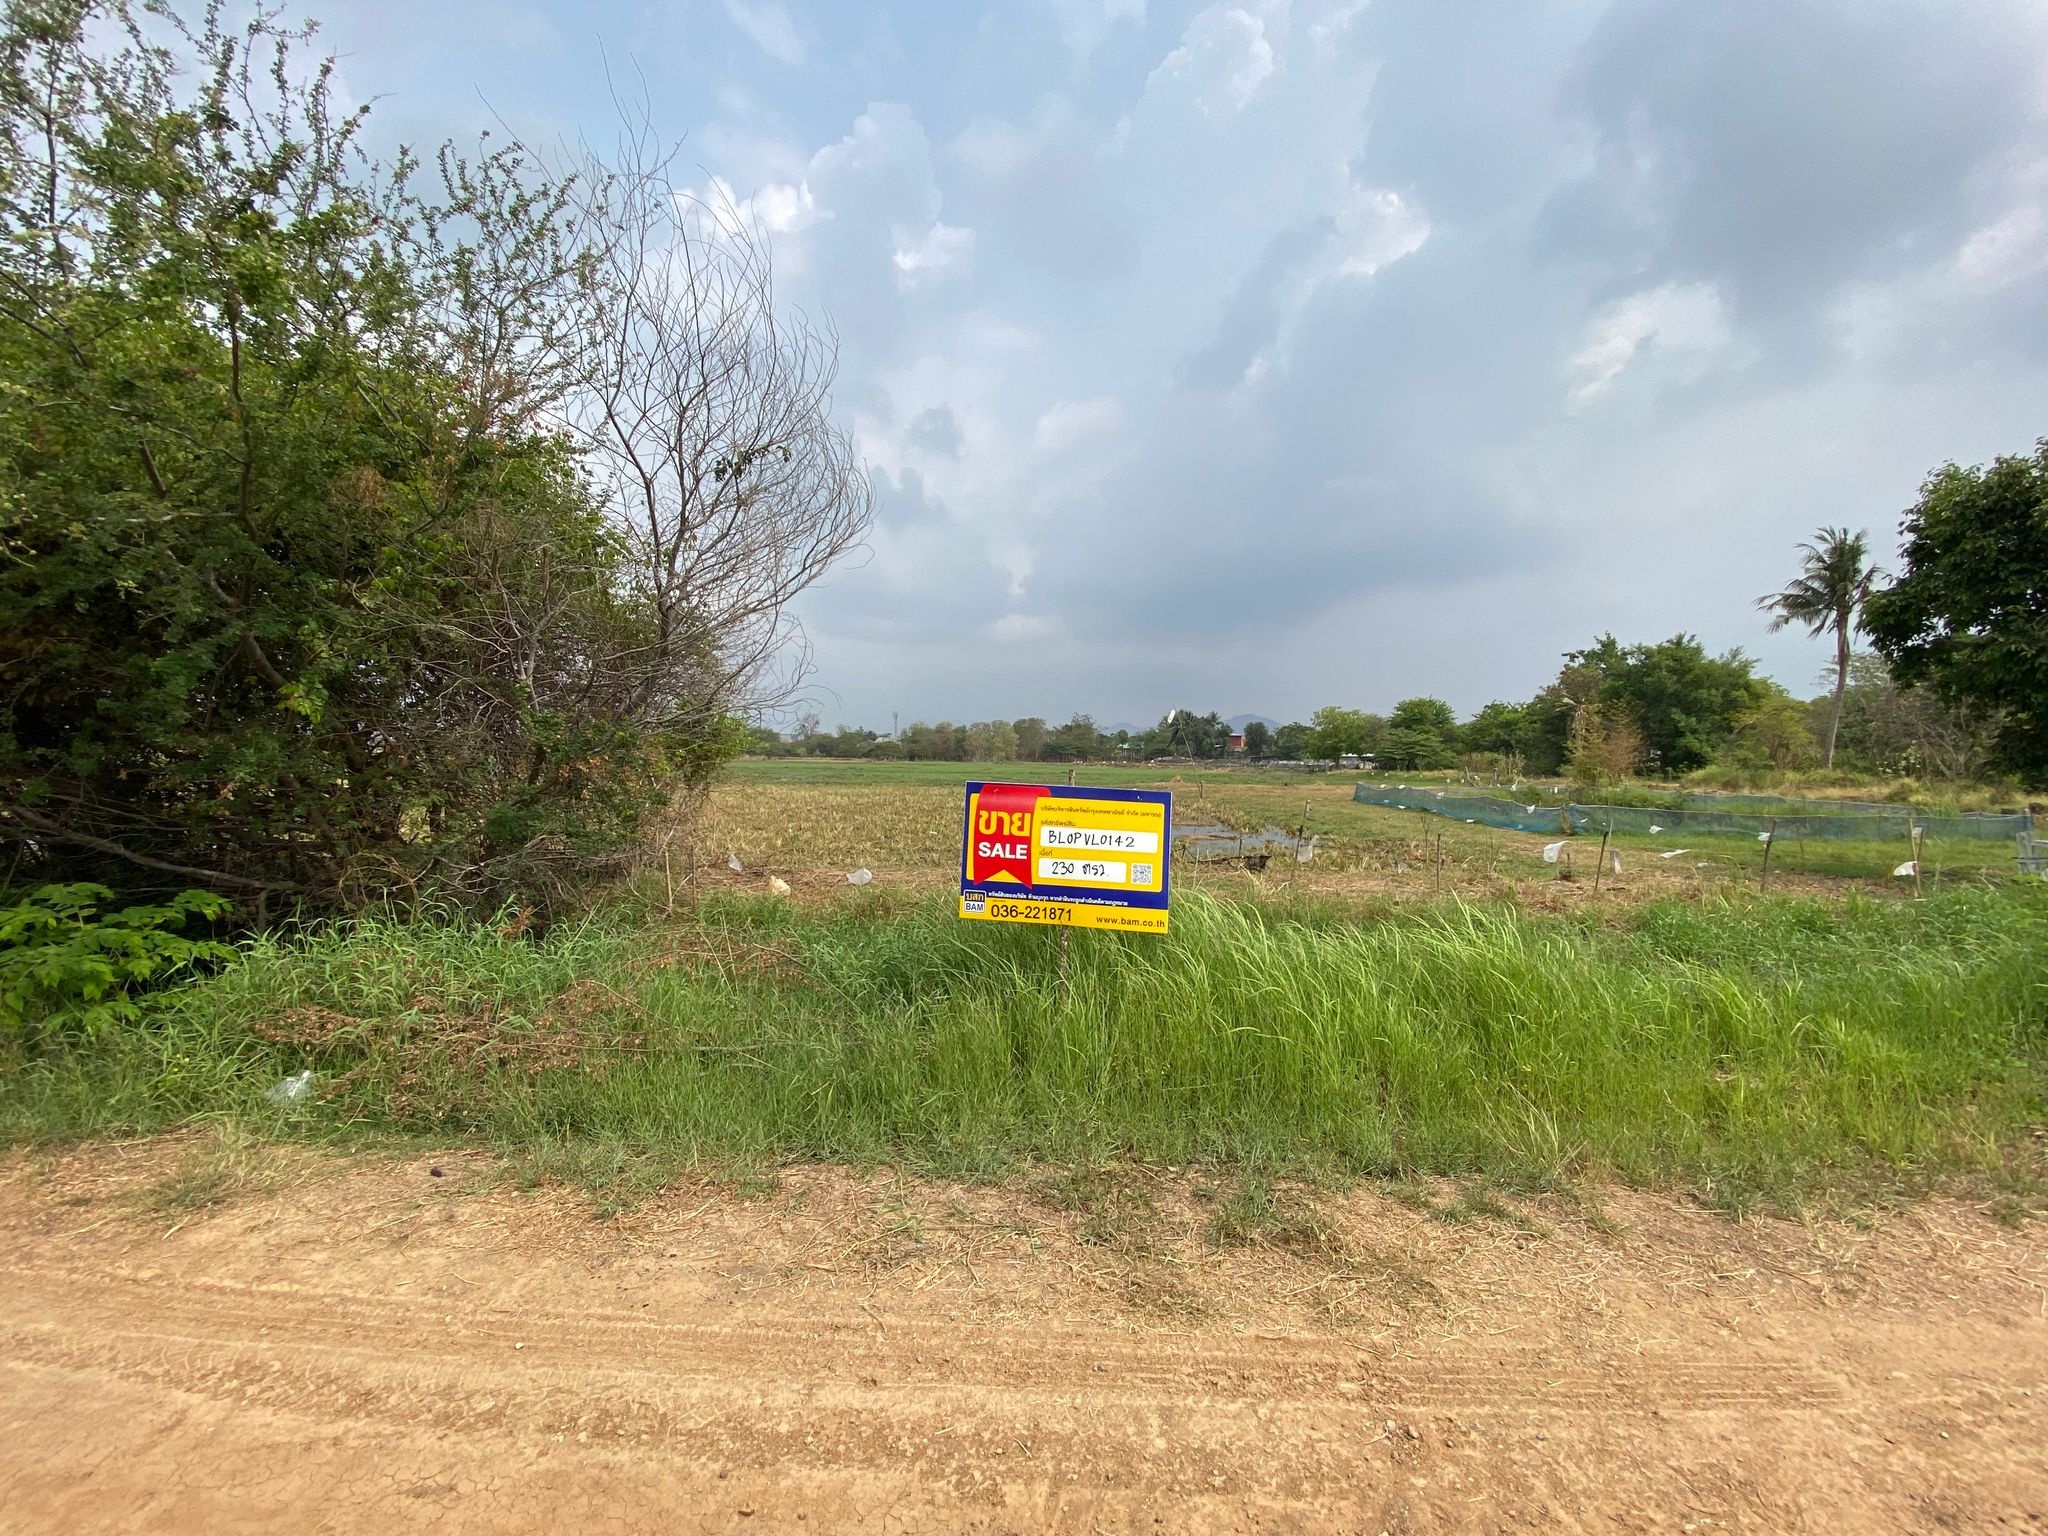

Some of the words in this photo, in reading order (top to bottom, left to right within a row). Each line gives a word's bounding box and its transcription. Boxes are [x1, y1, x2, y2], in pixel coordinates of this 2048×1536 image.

[979, 810, 1031, 837] ขาย
[978, 841, 1028, 860] SALE
[1051, 861, 1075, 876] 230
[965, 892, 984, 901] บสก
[965, 902, 984, 911] BAM
[991, 904, 1072, 921] 036-221871
[1096, 916, 1165, 928] www.bam.co.th
